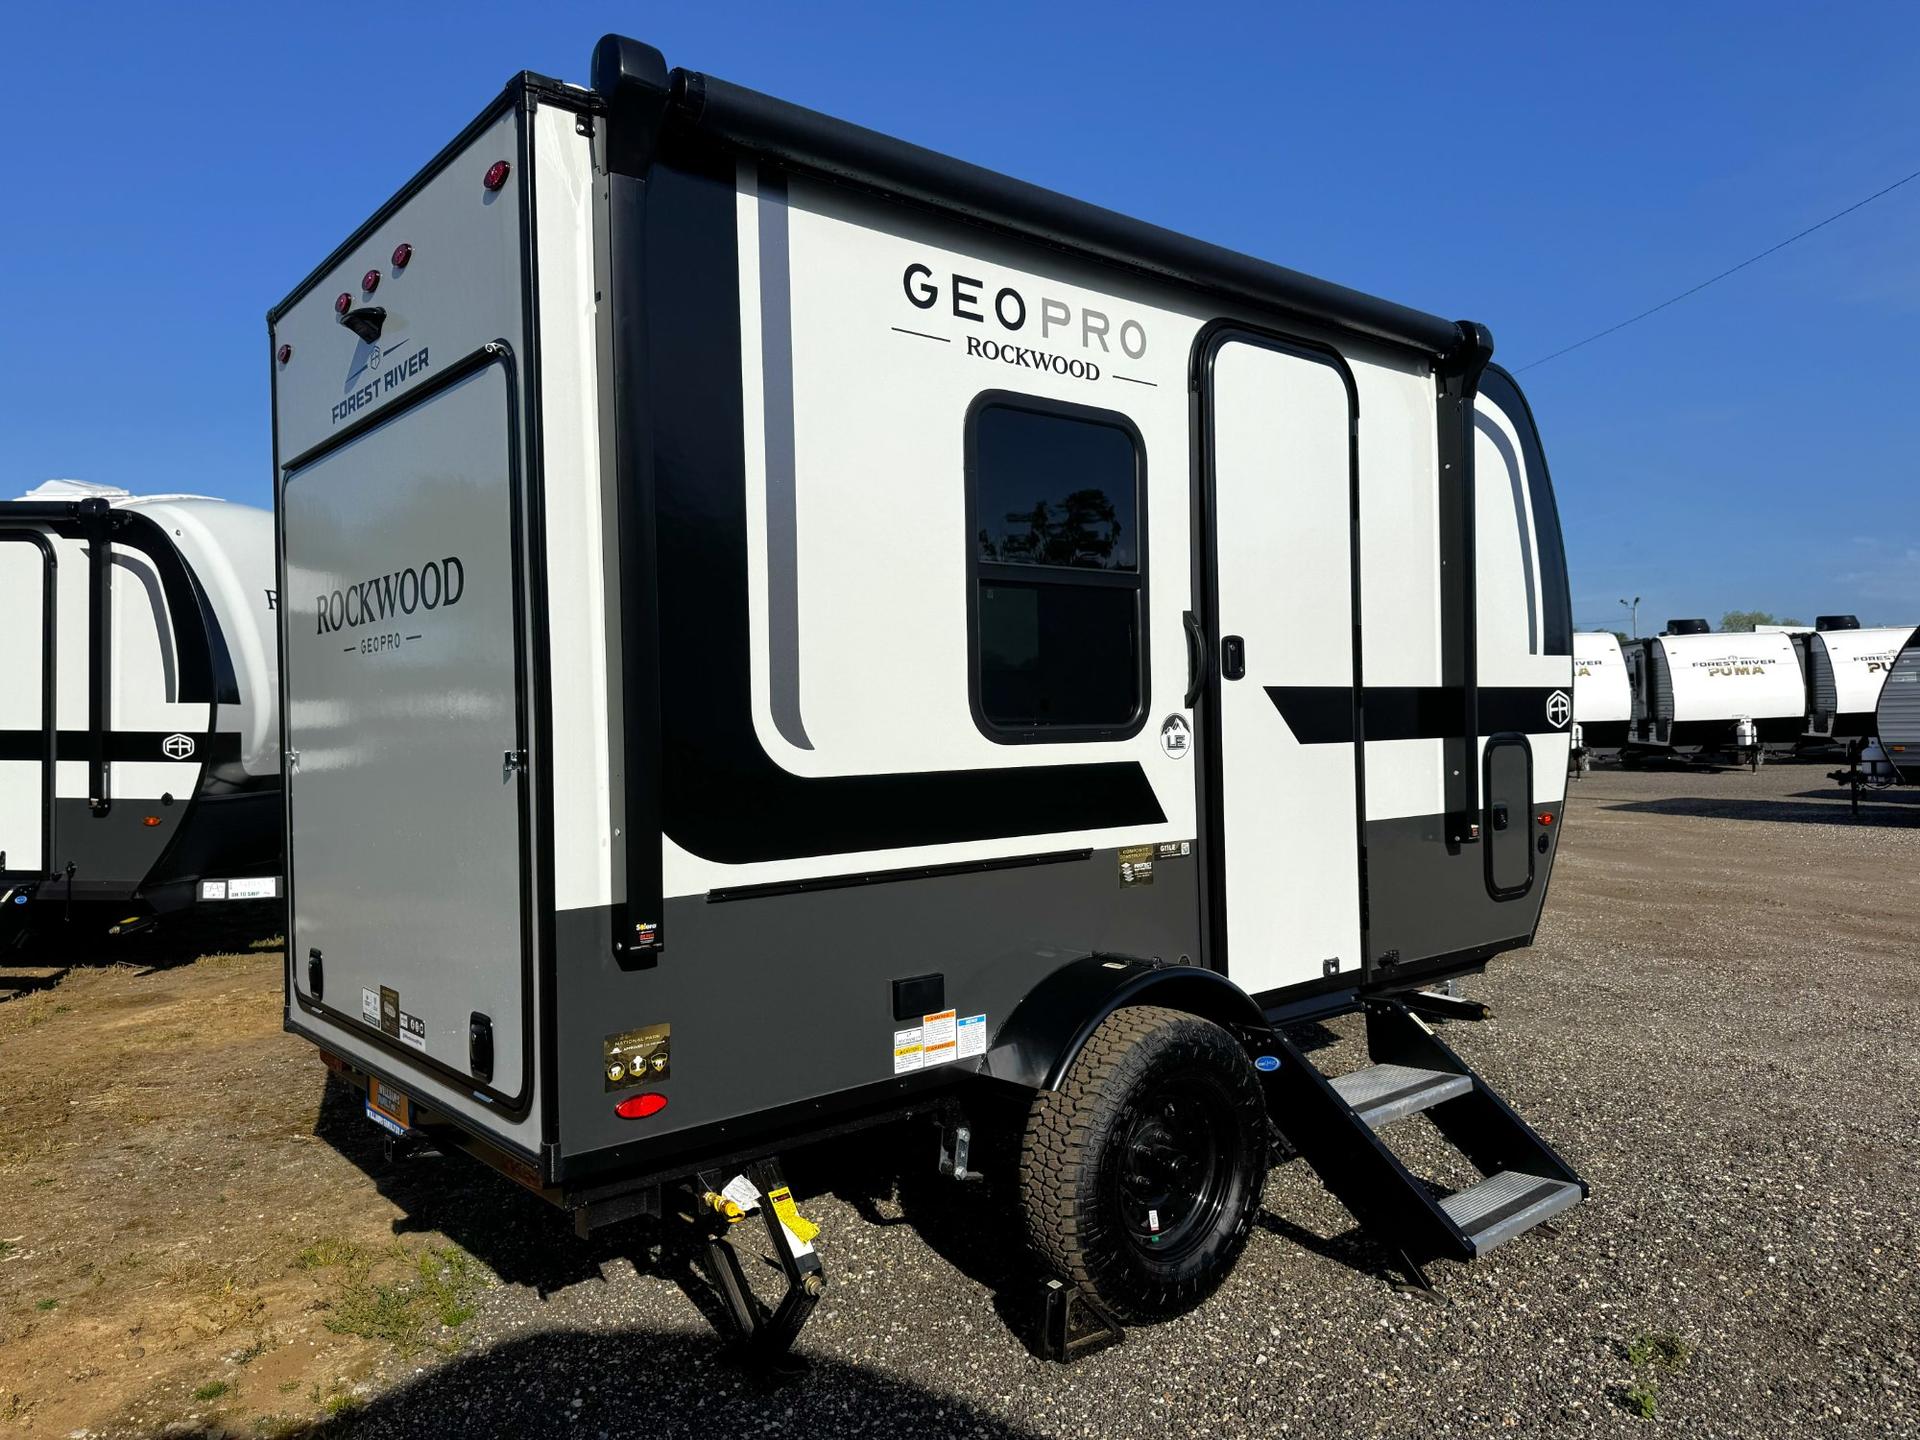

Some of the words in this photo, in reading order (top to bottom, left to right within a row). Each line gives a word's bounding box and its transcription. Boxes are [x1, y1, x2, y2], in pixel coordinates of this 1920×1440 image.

[966, 336, 1100, 381] ROCKWOOD
[331, 380, 380, 425] FOREST
[383, 347, 430, 393] RIVER
[316, 556, 465, 635] ROCKWOOD
[360, 632, 401, 655] GEOPRO
[1708, 667, 1765, 677] PUMA
[1867, 662, 1894, 673] PU
[1167, 735, 1186, 750] LE
